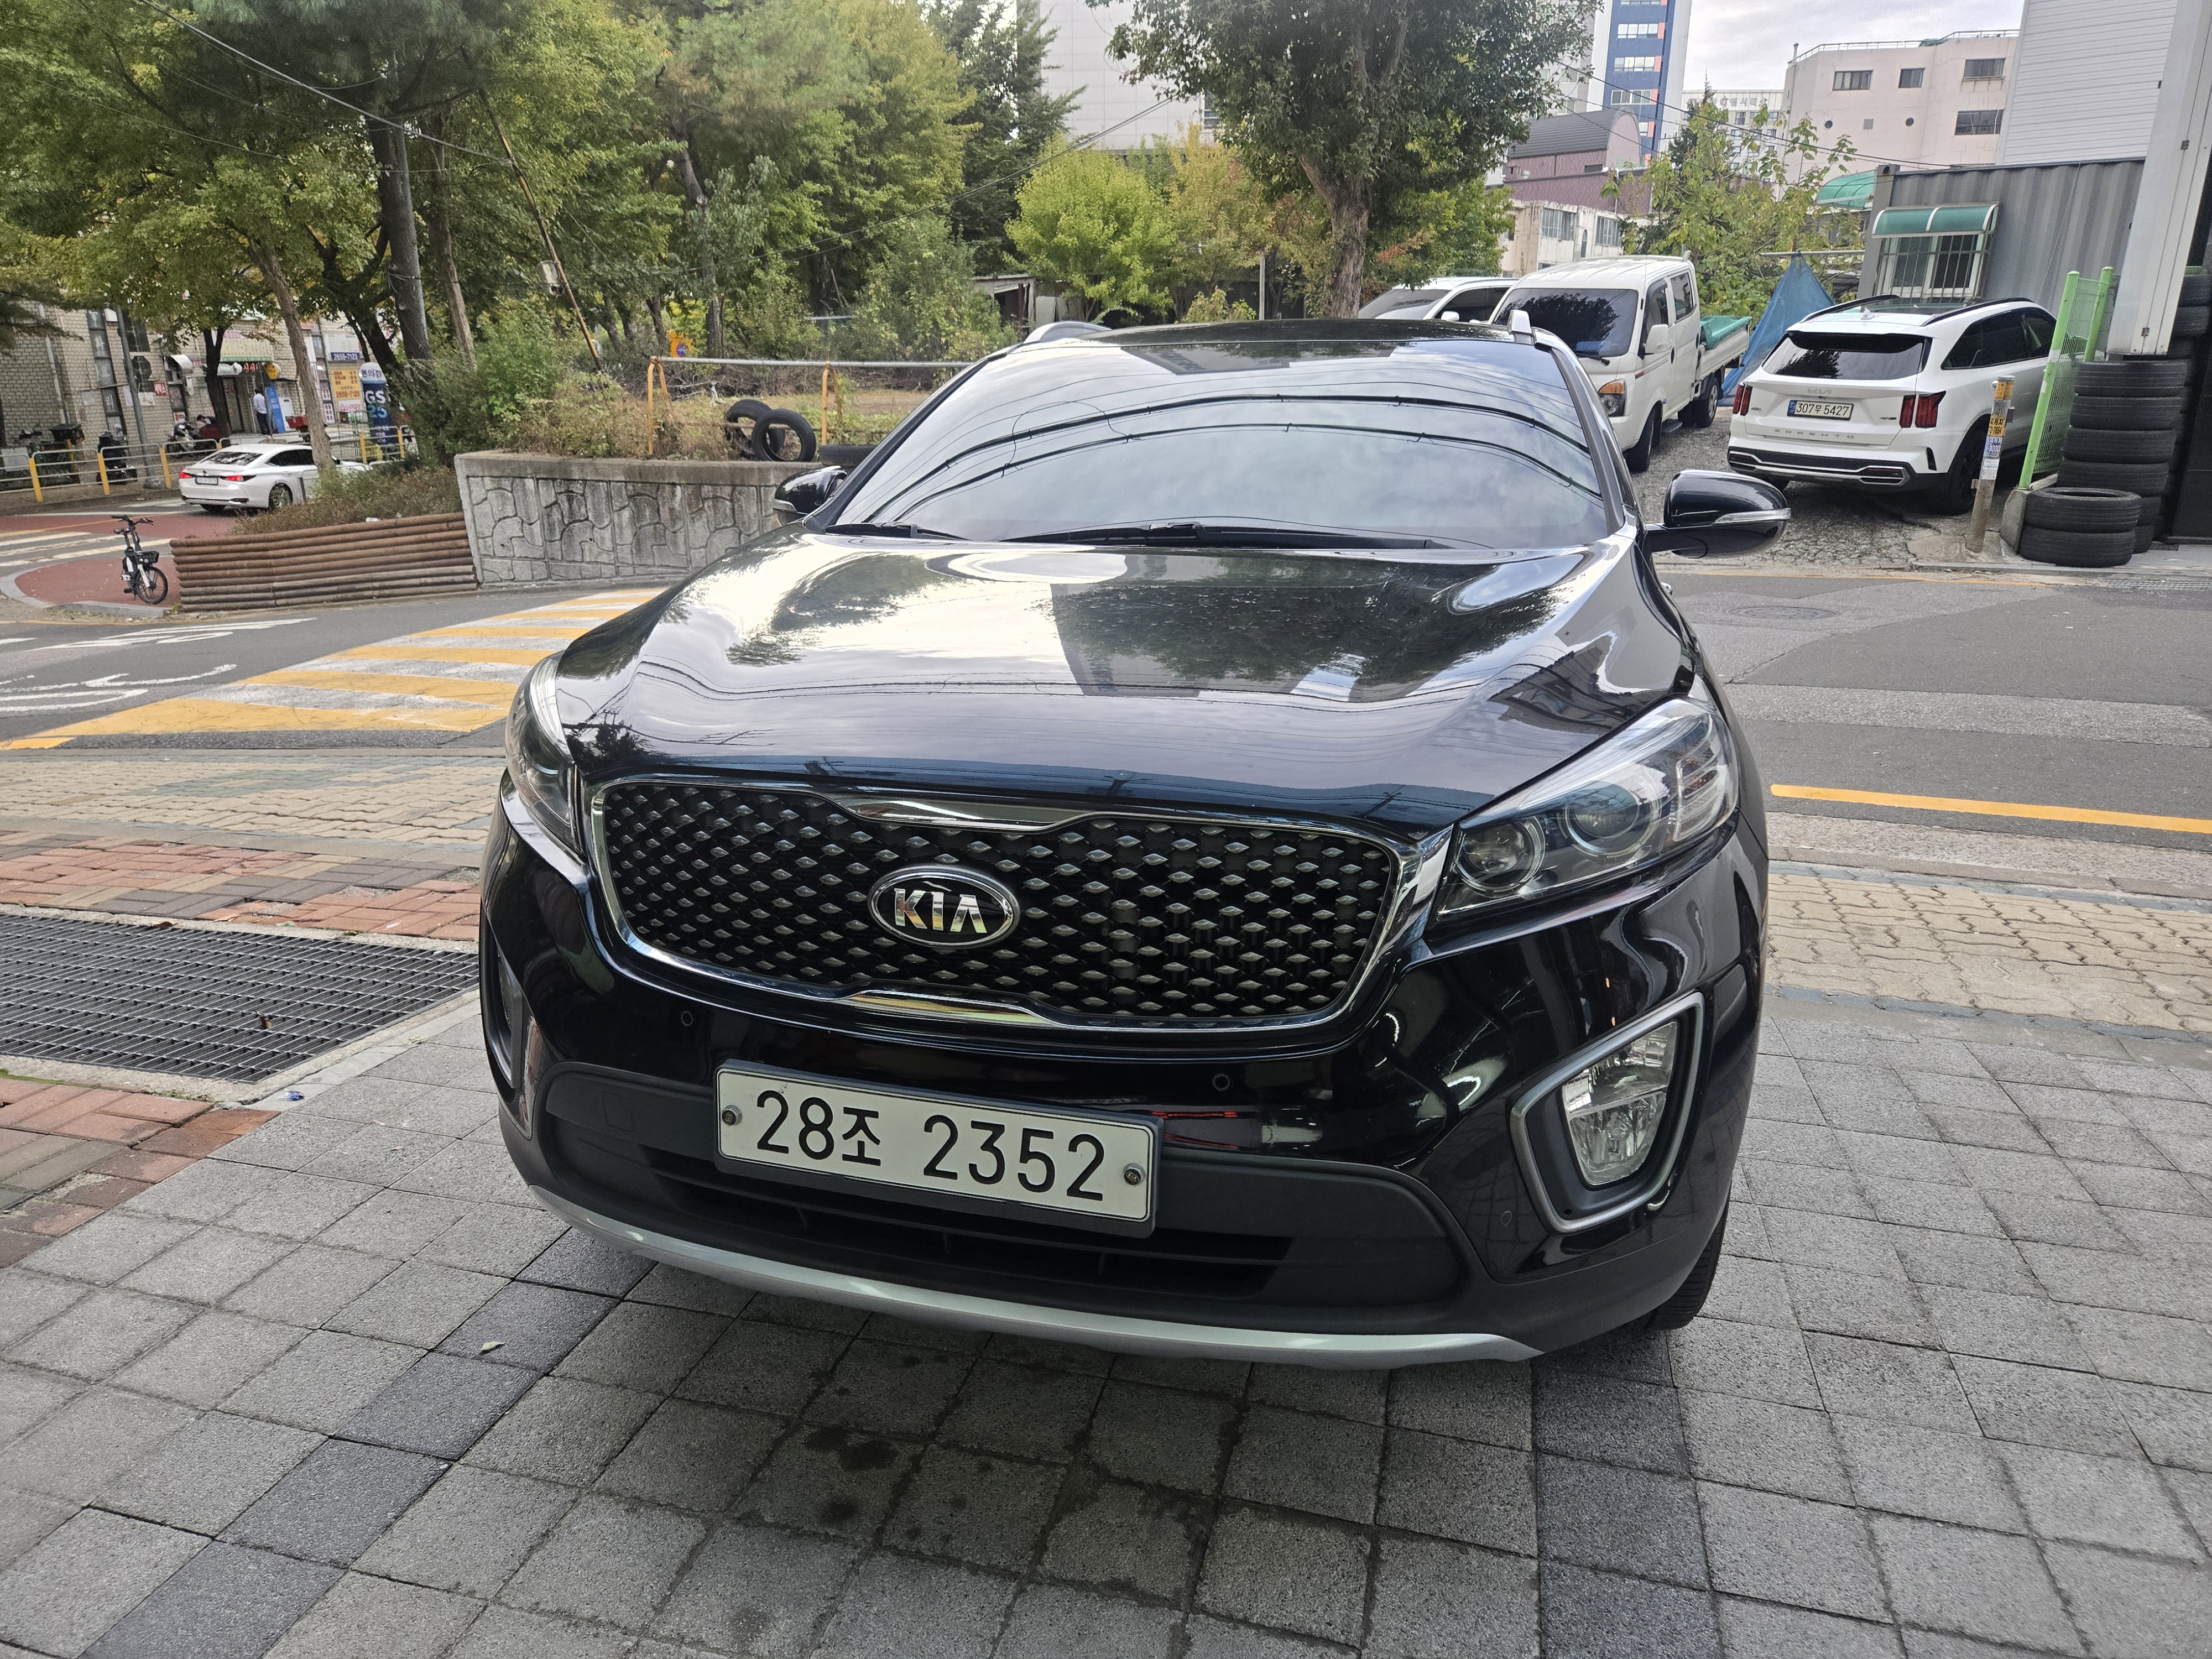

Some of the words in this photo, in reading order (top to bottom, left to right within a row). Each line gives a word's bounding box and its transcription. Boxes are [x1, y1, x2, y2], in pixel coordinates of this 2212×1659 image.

[365, 390, 386, 404] GS
[367, 405, 387, 419] 25
[1796, 403, 1822, 414] 307무
[1824, 405, 1849, 416] 5427
[894, 888, 988, 933] KIA
[757, 1090, 881, 1167] 28조
[923, 1114, 1105, 1202] 2352
